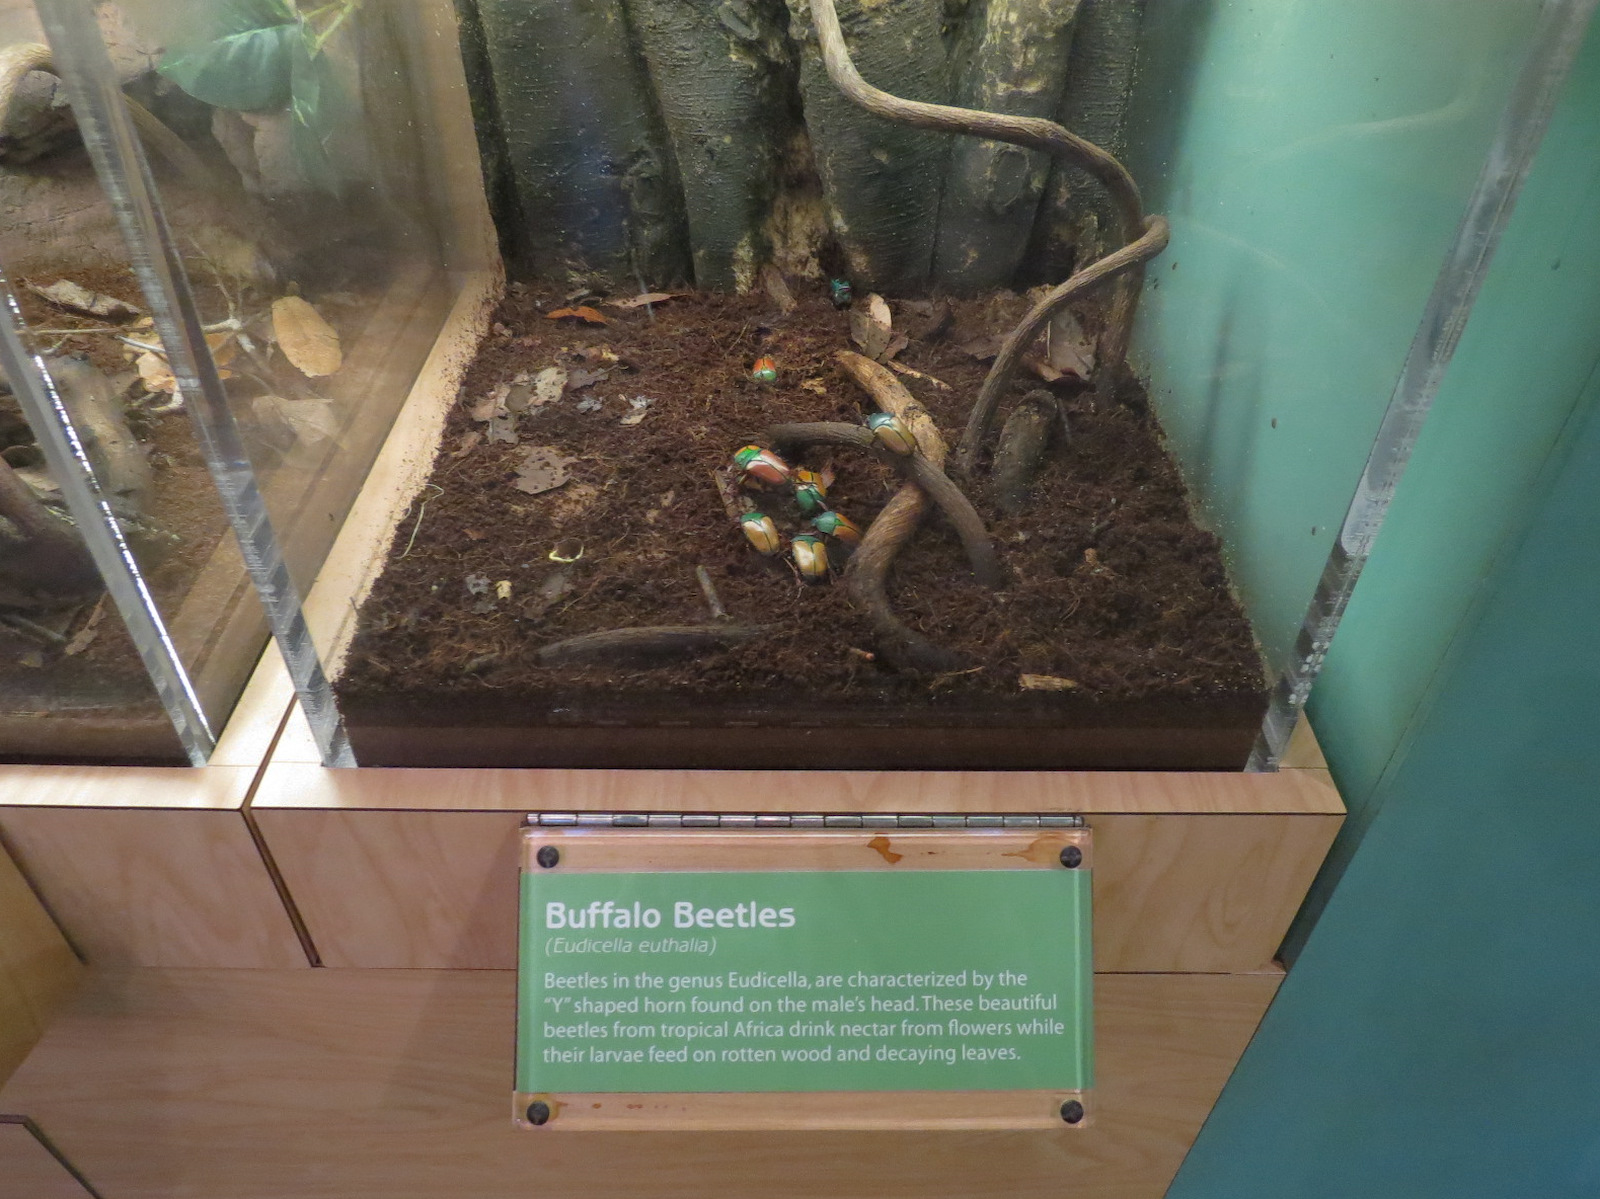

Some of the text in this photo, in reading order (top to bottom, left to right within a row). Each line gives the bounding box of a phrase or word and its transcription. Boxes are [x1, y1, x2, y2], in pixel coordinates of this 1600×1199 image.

[546, 901, 796, 929] Buffalo Beetles
[545, 938, 632, 956] (Eudicella
[545, 970, 1028, 992] Beetles in the genus Eudicella, are characterized by the
[574, 997, 638, 1016] shaped
[644, 997, 686, 1013] horn
[691, 996, 744, 1013] found
[749, 1000, 772, 1012] on
[777, 996, 807, 1012] the
[871, 995, 919, 1012] head.
[921, 995, 973, 1011] These
[979, 993, 1057, 1011] beautiful
[544, 1018, 1064, 1041] beetles from tropical Africa drink nectar from flowers while
[542, 1044, 1021, 1065] their larvae feed on rotten wood and decaying leaves.
